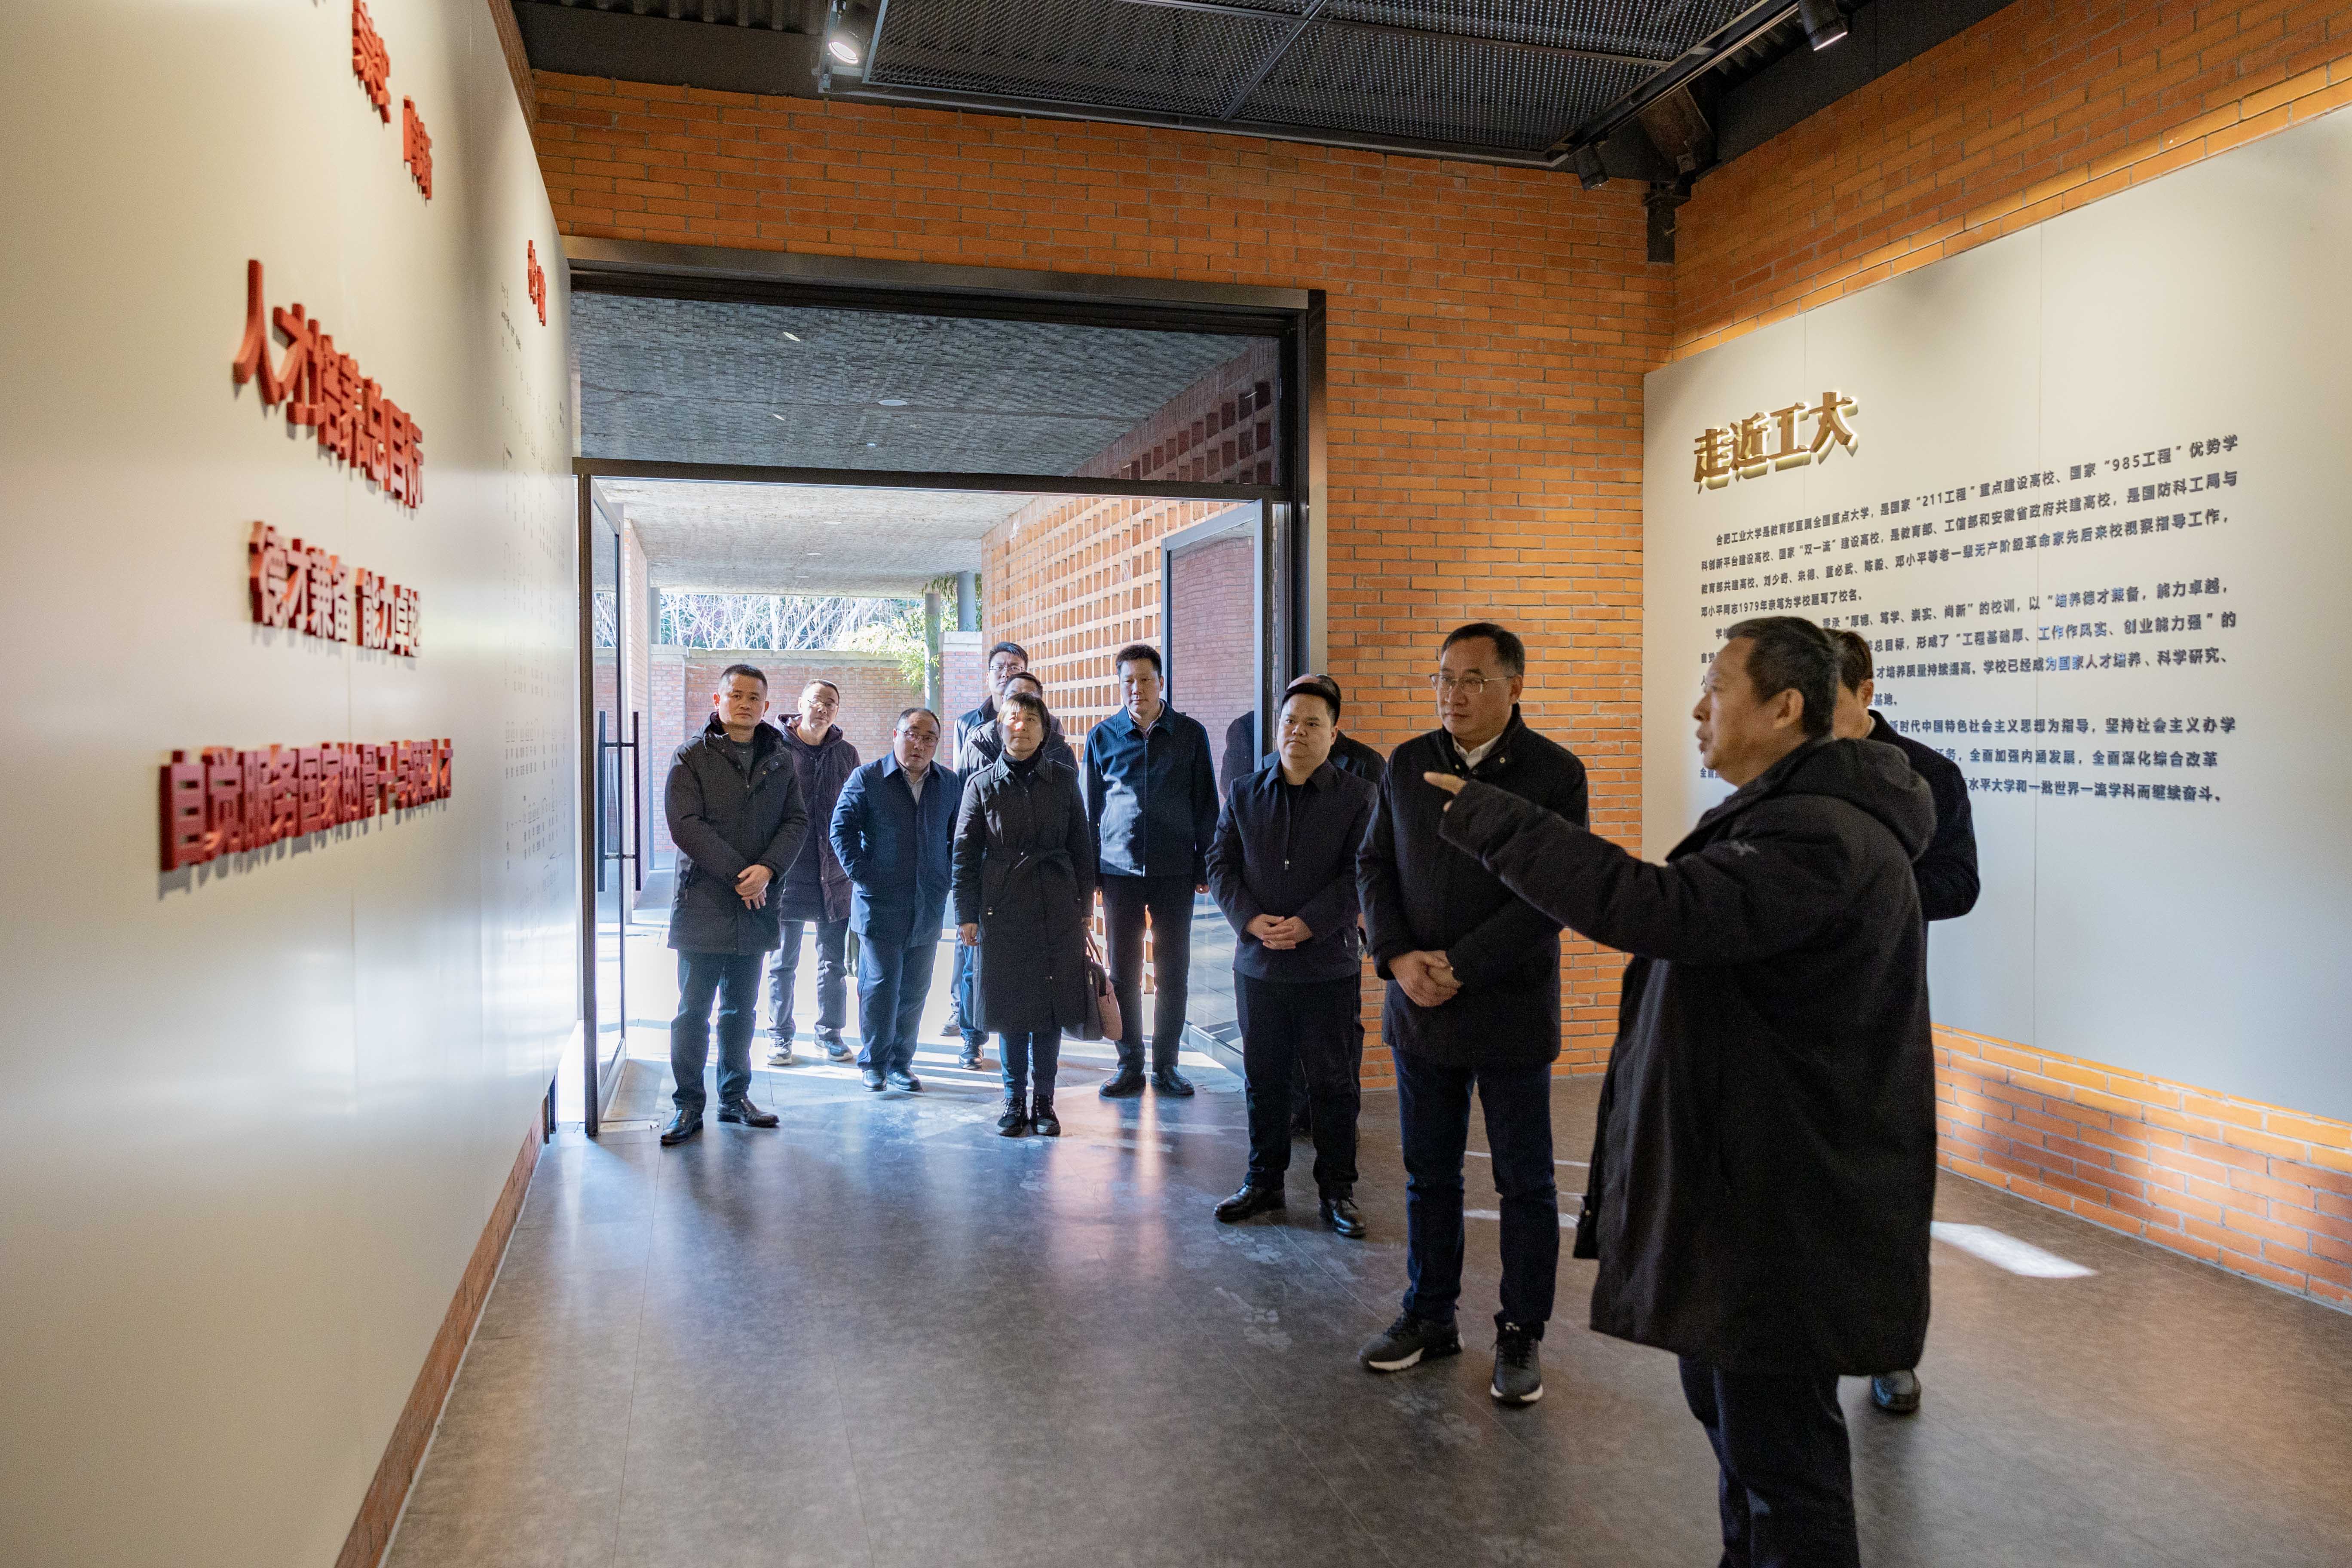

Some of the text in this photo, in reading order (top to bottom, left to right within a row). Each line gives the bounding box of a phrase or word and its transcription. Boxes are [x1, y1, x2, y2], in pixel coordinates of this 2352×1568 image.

[233, 259, 424, 509] 人才培养总目标
[1694, 392, 1854, 484] 走近工大
[248, 521, 350, 642] 德才兼备
[355, 567, 421, 658] 能力卓越
